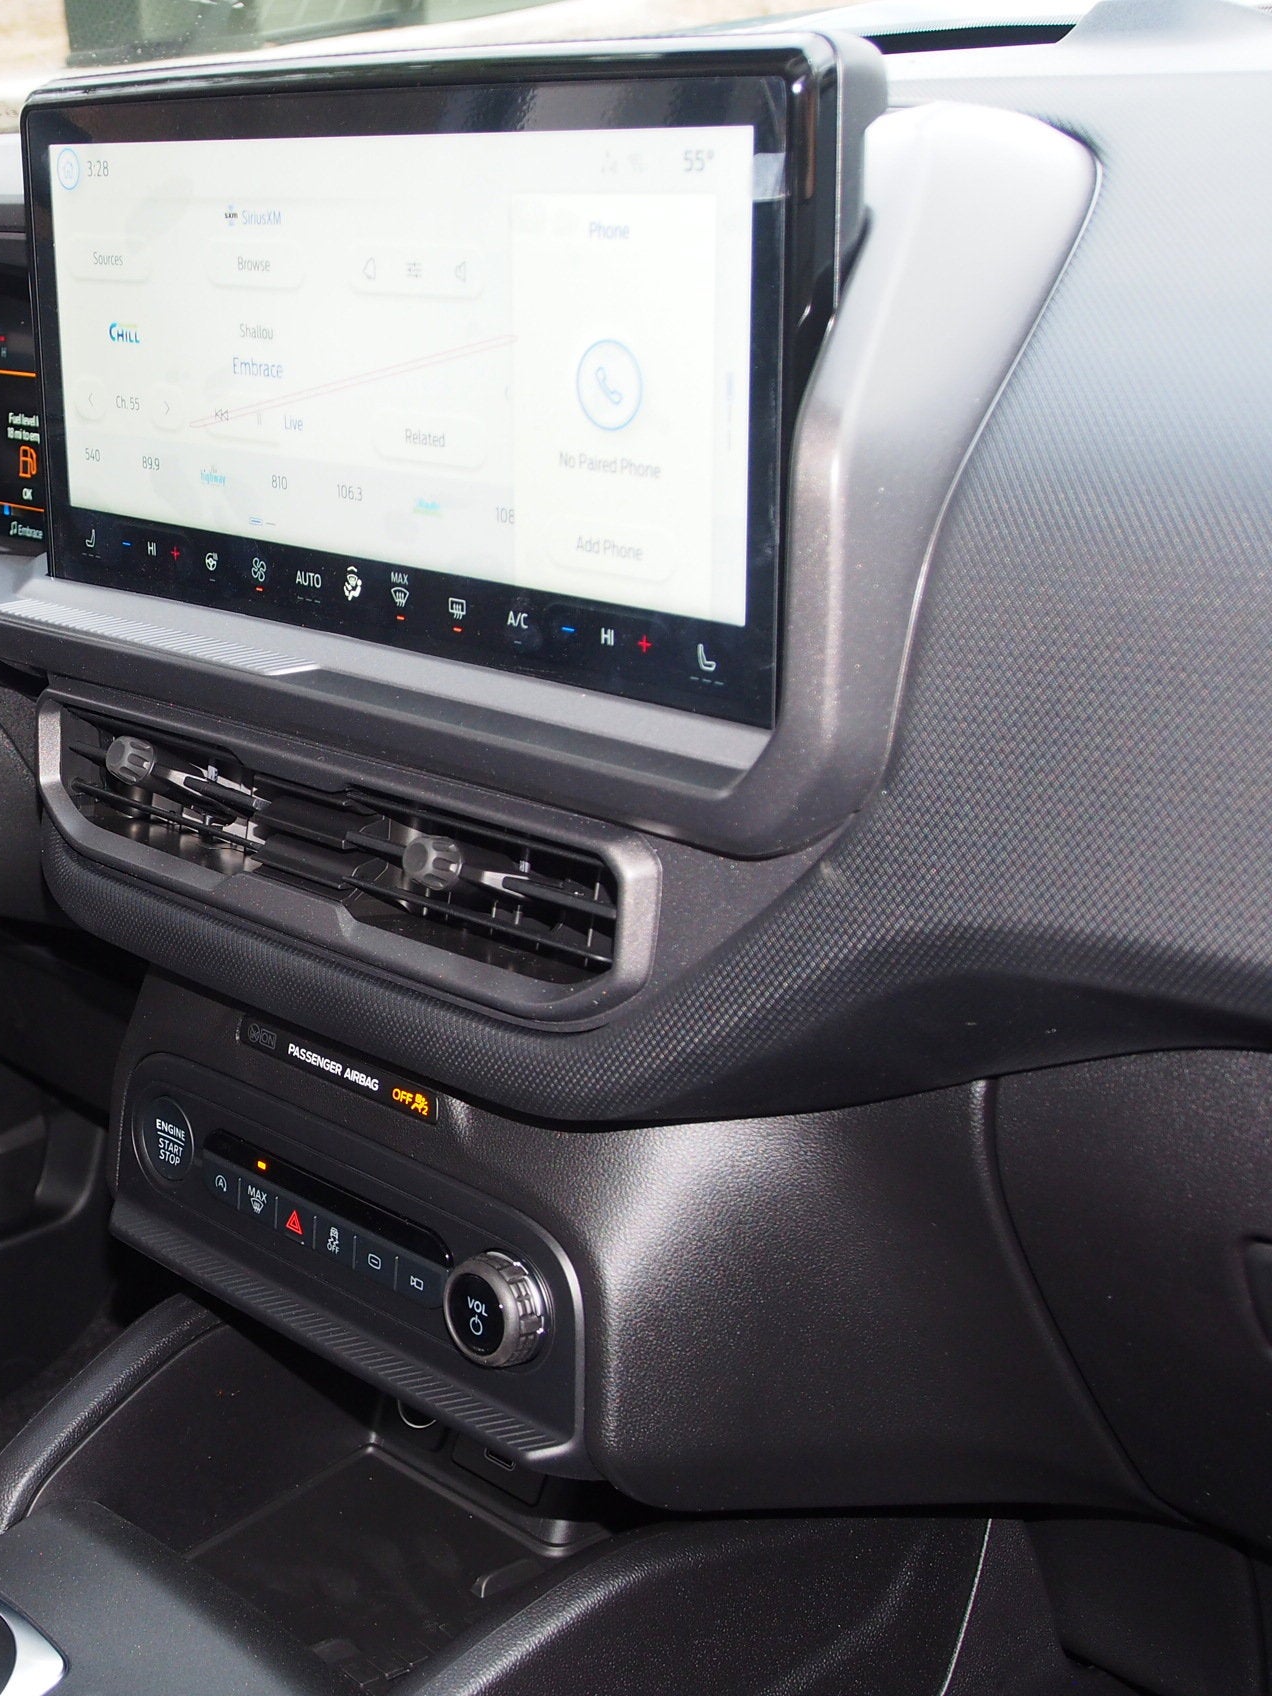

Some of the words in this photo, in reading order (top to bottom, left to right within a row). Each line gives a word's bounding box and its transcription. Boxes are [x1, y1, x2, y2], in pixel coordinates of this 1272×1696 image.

[87, 160, 109, 177] 3:28
[241, 210, 282, 226] SiriusXM
[588, 221, 630, 239] Phone
[92, 251, 123, 267] Sources
[237, 256, 271, 272] Browse
[239, 323, 274, 341] Shallou
[232, 356, 284, 378] Embrace
[129, 397, 140, 411] 55
[284, 416, 303, 431] Live
[404, 429, 446, 448] Related
[85, 449, 101, 463] 540
[142, 456, 160, 471] 89.9
[559, 451, 576, 469] No
[578, 453, 618, 475] Paired
[620, 458, 661, 479] Phone
[271, 475, 288, 490] 810
[22, 487, 33, 500] OK
[336, 484, 363, 502] 106.3
[18, 524, 43, 539] Embrace
[148, 541, 156, 556] HI
[575, 535, 600, 555] Add
[603, 539, 643, 561] Phone
[296, 570, 321, 588] AUTO
[391, 572, 408, 585] MAX
[507, 611, 528, 629] A/C
[601, 628, 614, 646] HI
[288, 1043, 342, 1076] PASSENGER
[344, 1067, 379, 1091] AIRBAG
[392, 1088, 413, 1105] OFF
[156, 1118, 185, 1141] ENGINE
[158, 1138, 183, 1157] START
[159, 1149, 181, 1166] STOP
[248, 1185, 267, 1203] MAX
[327, 1243, 340, 1254] OFF
[467, 1296, 488, 1317] VOL
